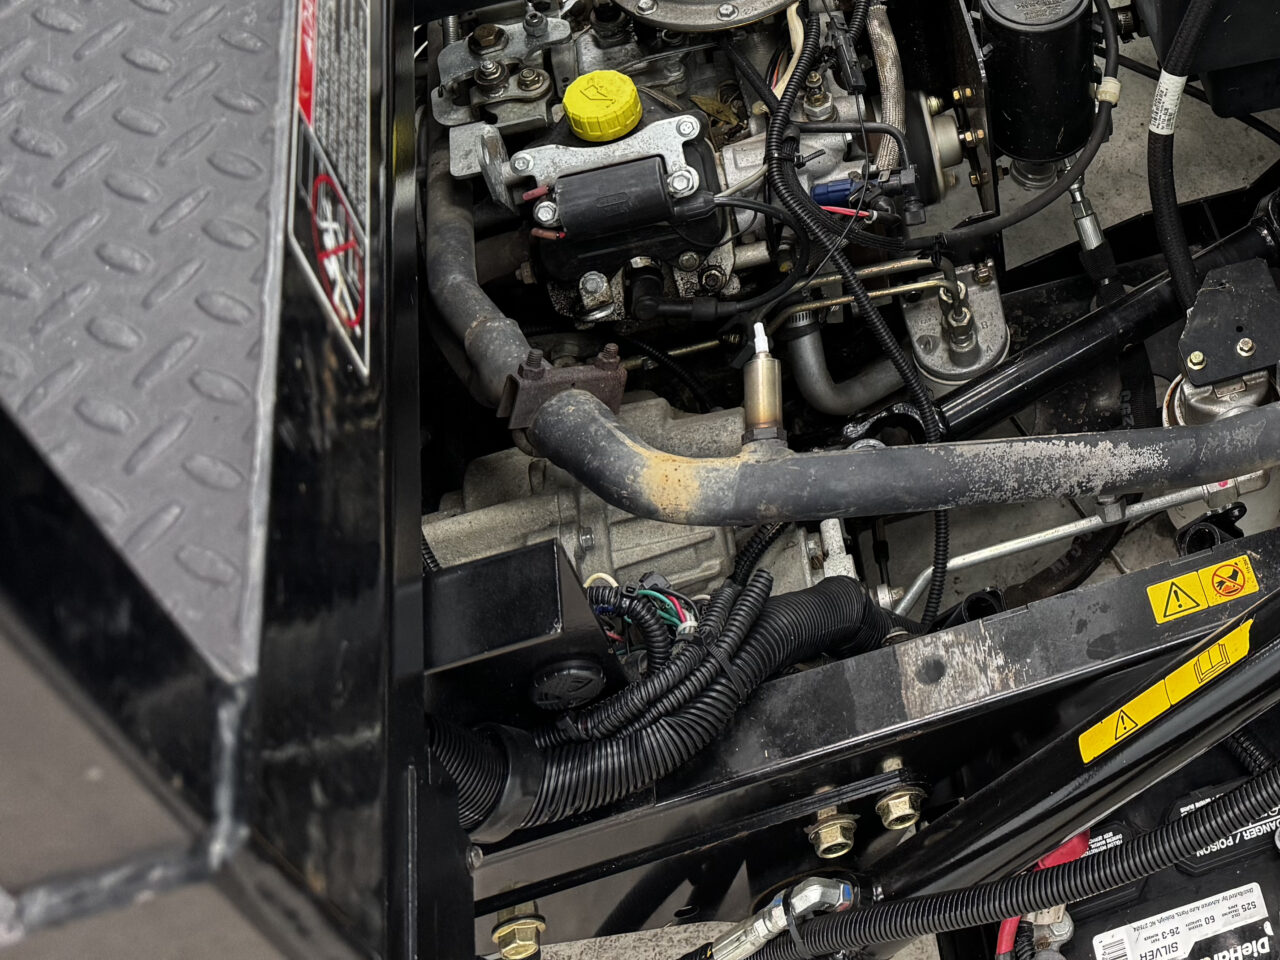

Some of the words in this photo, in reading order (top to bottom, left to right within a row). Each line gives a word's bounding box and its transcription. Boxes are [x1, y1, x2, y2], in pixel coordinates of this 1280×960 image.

[1195, 837, 1234, 857] POISON
[1188, 904, 1201, 913] Auto
[1200, 897, 1221, 909] Advance
[1240, 899, 1257, 912] 525
[1203, 914, 1215, 924] 60
[1160, 926, 1180, 939] 26-3
